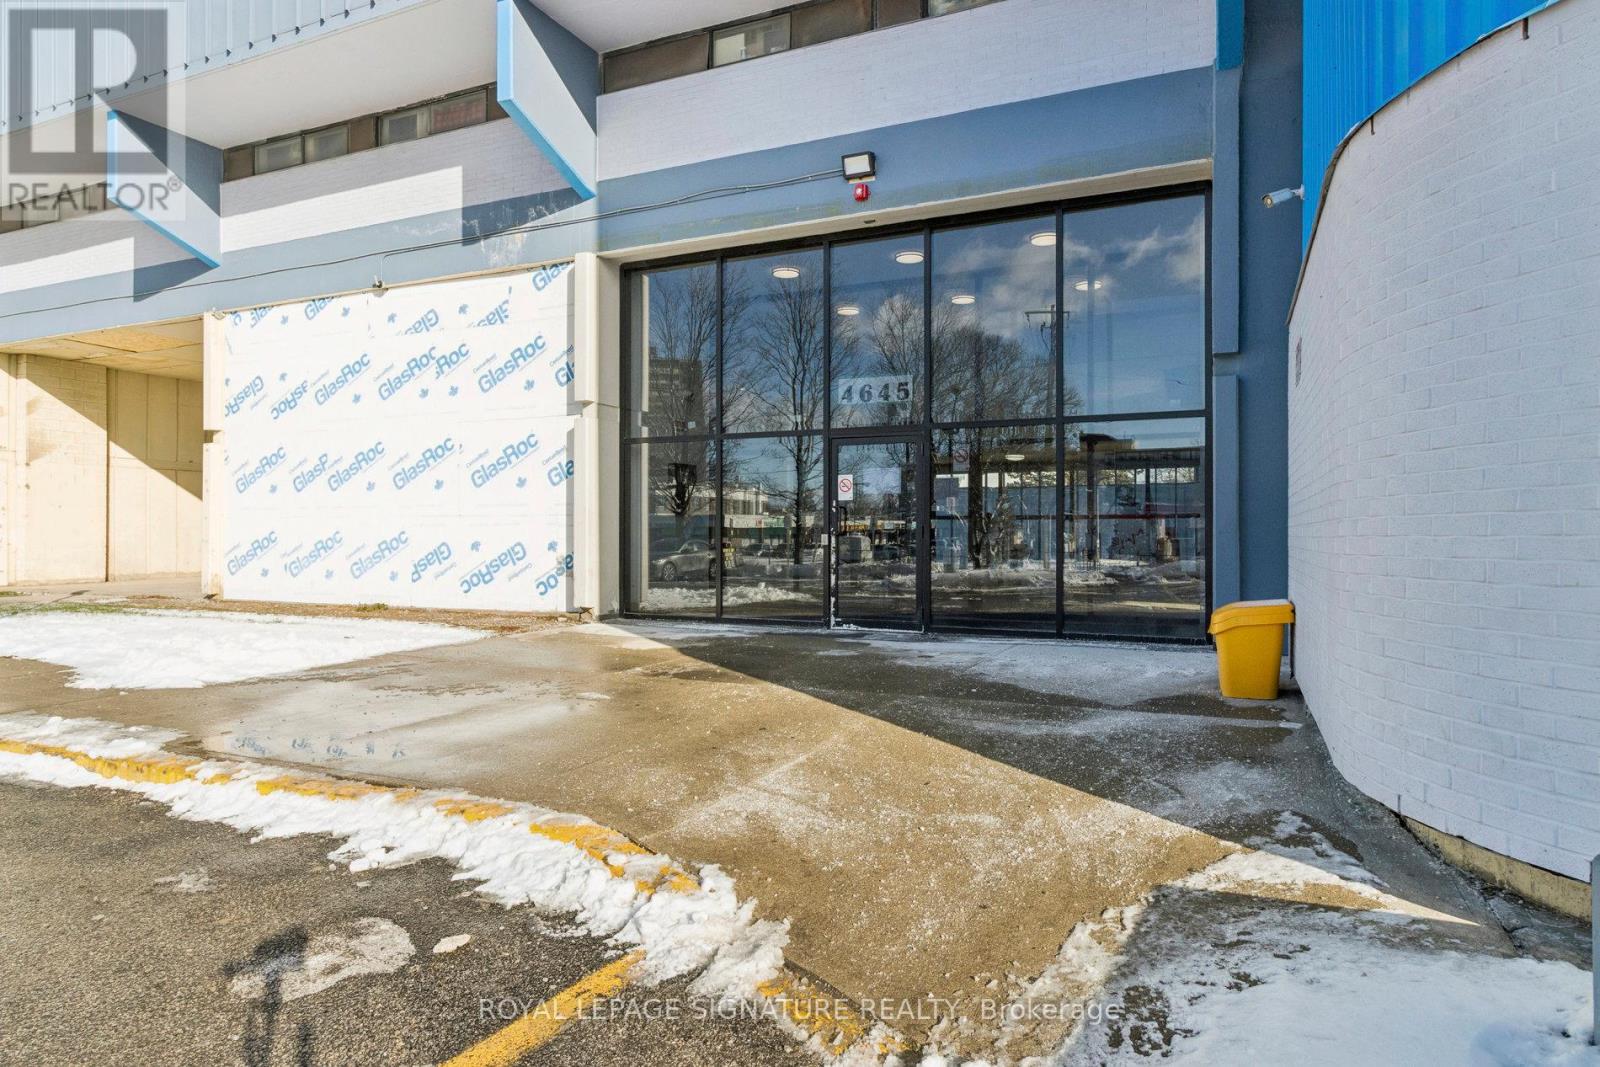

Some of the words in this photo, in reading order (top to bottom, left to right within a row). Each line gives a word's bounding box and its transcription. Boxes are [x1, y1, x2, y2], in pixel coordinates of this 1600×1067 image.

[314, 353, 371, 406] GlasRoc
[477, 335, 546, 393] GlasRoc
[842, 382, 910, 403] 4645
[235, 447, 286, 494] GlasRoc
[328, 441, 385, 492] GlasRoc
[393, 437, 455, 490] GlasRoc
[470, 433, 538, 488] GlasRoc
[227, 531, 278, 576] GlasRoc
[288, 531, 343, 578] GlasRoc
[350, 531, 409, 579] GlasRoc
[460, 541, 527, 594] GlasRoc
